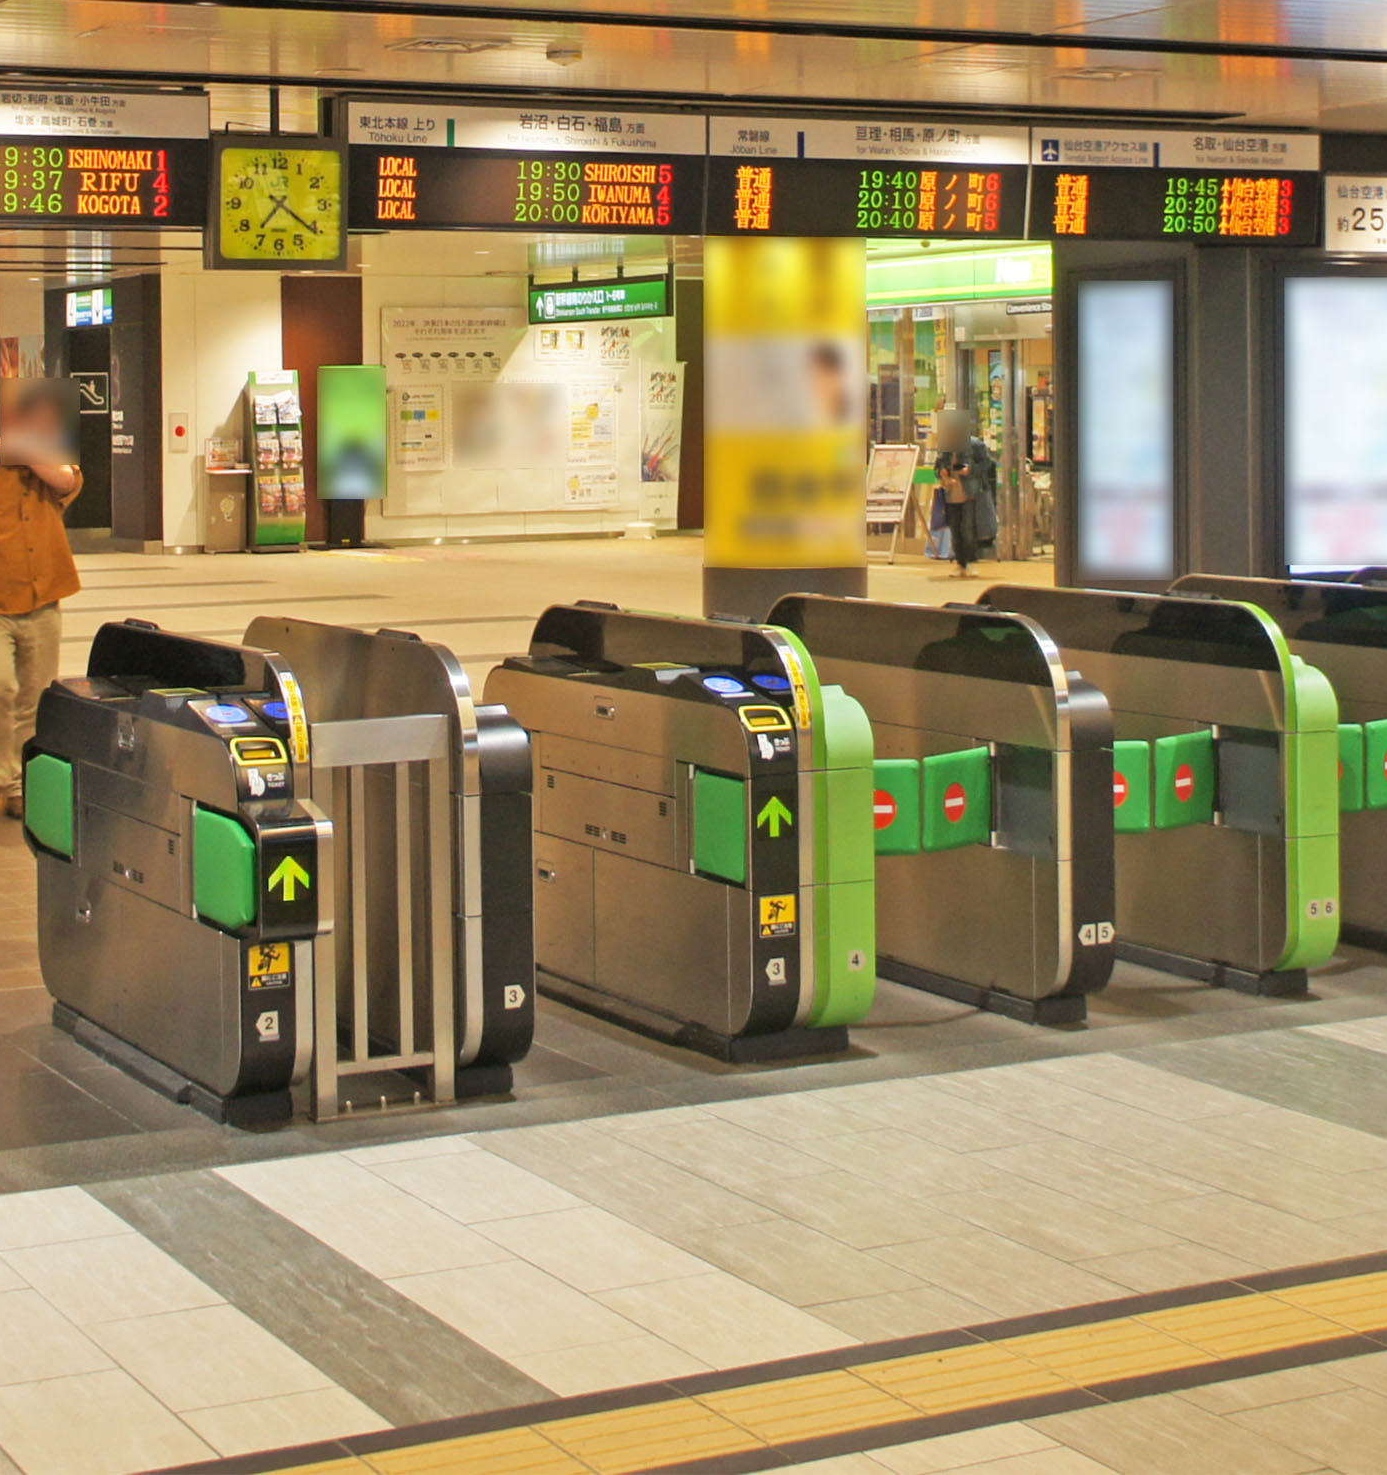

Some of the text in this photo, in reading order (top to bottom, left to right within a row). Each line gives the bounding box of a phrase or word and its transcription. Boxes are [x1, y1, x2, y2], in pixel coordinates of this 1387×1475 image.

[359, 116, 436, 131] 東北本線 上り
[406, 132, 429, 144] Line
[67, 149, 153, 171] ISHINOMAKI
[156, 150, 167, 172] 1
[272, 157, 289, 170] 12
[296, 163, 303, 175] 1
[379, 156, 673, 185] LOCAL 19:30 SHIROISHI 5
[735, 166, 1001, 192] 普通 19:40 6
[79, 172, 141, 193] RIFU
[152, 173, 170, 194] 4
[309, 176, 321, 189] 2
[378, 178, 672, 206] LOCAL 19:50 IWANUMA 4
[1055, 174, 1090, 197] 普通
[1165, 177, 1218, 196] 19:45
[1281, 179, 1294, 198] 3
[76, 194, 142, 215] KOGOTA
[153, 195, 170, 217] 2
[230, 197, 328, 211] 9 3
[735, 189, 1000, 212] 普通 20:10 6
[1054, 196, 1088, 216] 普通
[1163, 196, 1217, 215] 20:20
[1280, 198, 1292, 216] 3
[377, 199, 415, 222] LOCAL
[514, 203, 580, 225] 20:00
[656, 205, 672, 227] 5
[734, 209, 999, 231] 普通 20:40 5
[239, 219, 251, 232] 8
[1053, 215, 1087, 235] 普通
[1162, 215, 1215, 234] 20:50
[1278, 216, 1291, 235] 3
[255, 233, 304, 252] 7 6 5
[1309, 900, 1333, 916] 5 6
[1083, 924, 1110, 942] 4 5
[772, 962, 781, 976] 3
[851, 953, 860, 967] 4
[507, 988, 519, 1004] 3
[264, 1016, 274, 1030] 2
